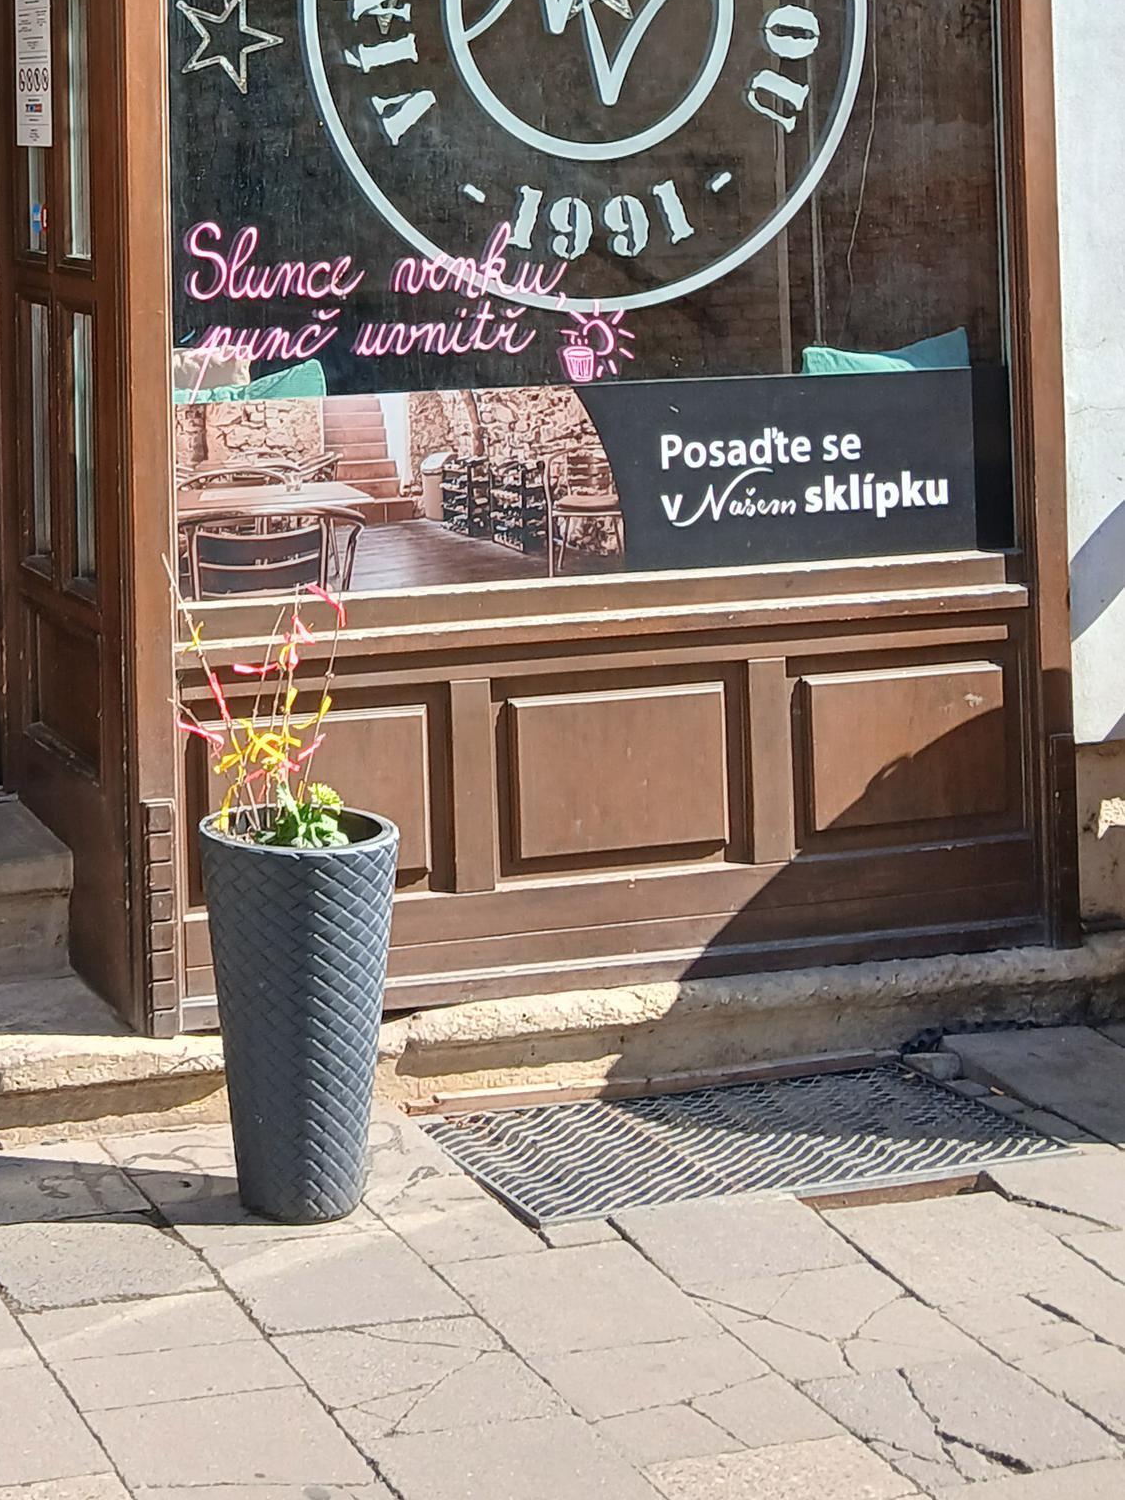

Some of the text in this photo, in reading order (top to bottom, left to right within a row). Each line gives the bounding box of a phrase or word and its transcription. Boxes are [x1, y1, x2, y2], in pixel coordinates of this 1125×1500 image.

[187, 222, 366, 299] Slunce
[189, 307, 341, 404] punč
[660, 427, 862, 470] Posaďte se
[661, 467, 949, 527] v Našem sklípku
